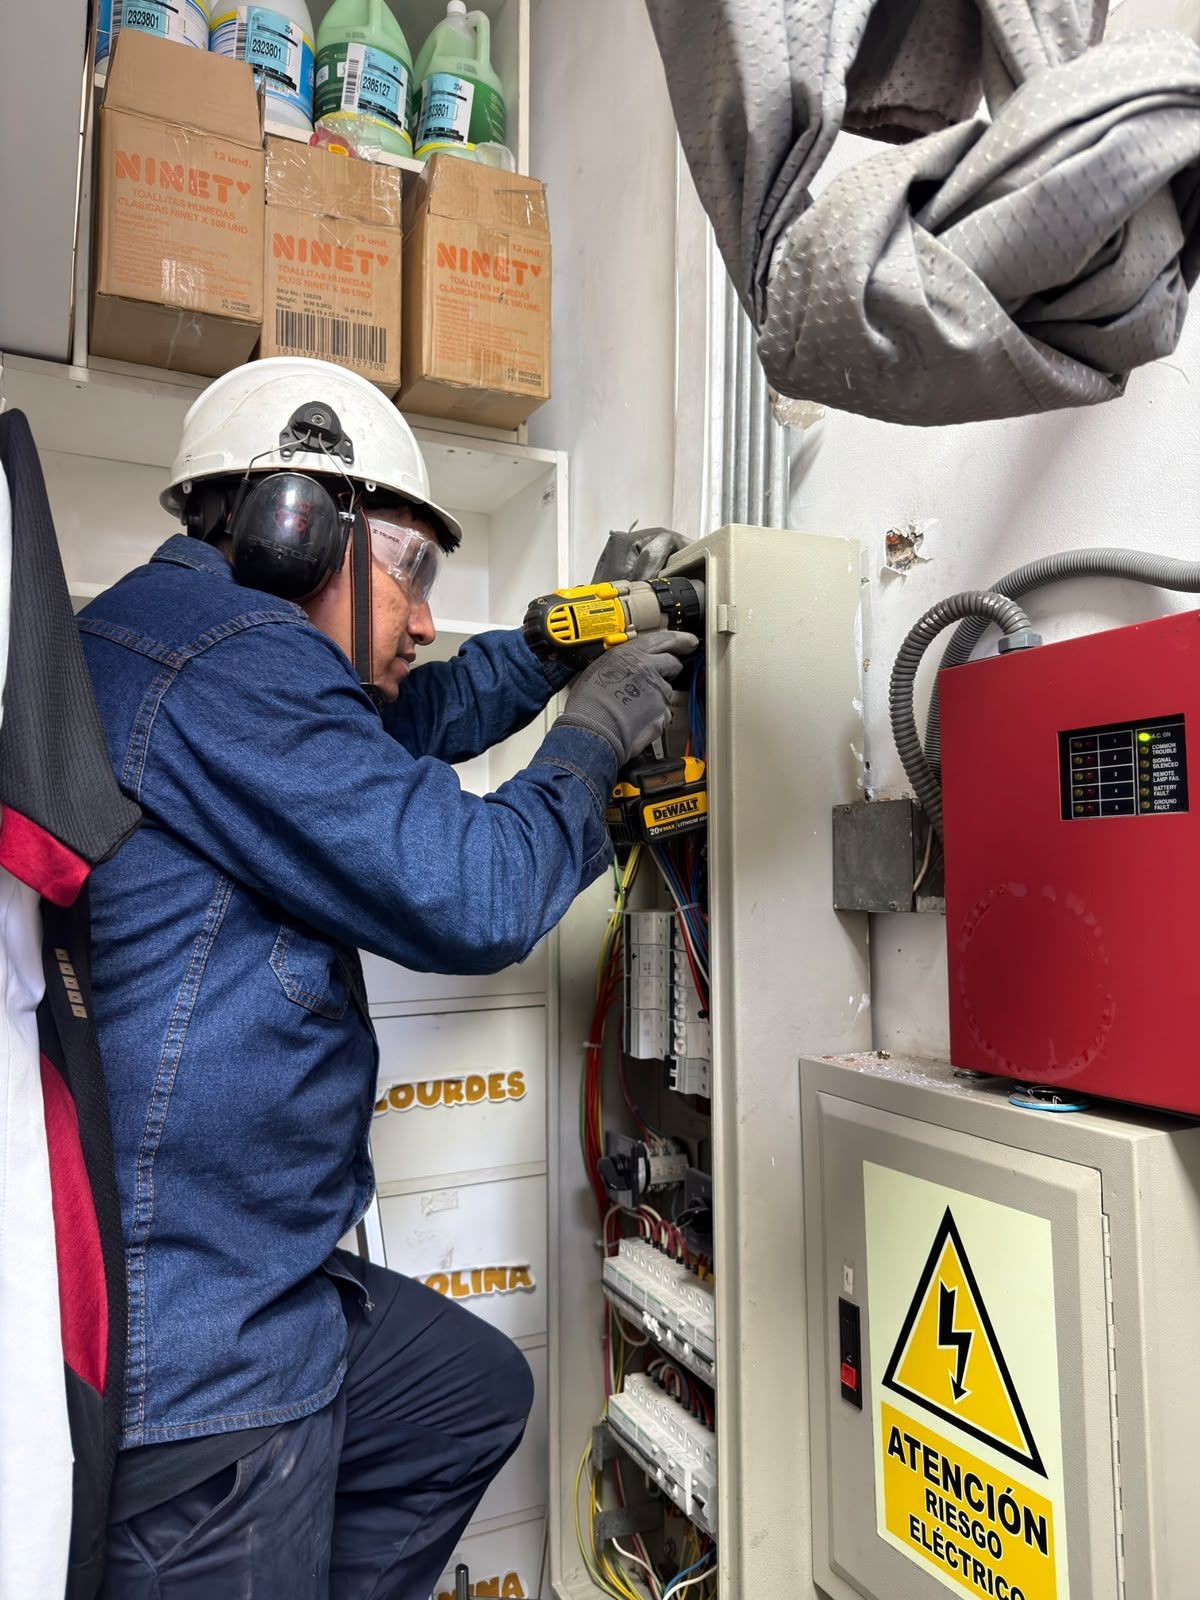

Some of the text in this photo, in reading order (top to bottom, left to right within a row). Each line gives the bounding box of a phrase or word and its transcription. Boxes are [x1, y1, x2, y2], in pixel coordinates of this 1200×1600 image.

[127, 10, 159, 29] 2323801
[252, 38, 282, 60] 2323801
[213, 151, 226, 162] 12
[115, 150, 234, 204] NINET
[133, 188, 236, 221] TOALLITAS HUMEDAS
[117, 196, 169, 216] CLASICAS
[169, 209, 198, 223] NINET
[201, 216, 209, 226] X
[227, 221, 249, 235] UND
[273, 232, 374, 276] NINET
[277, 264, 326, 280] TOALLITAS
[437, 242, 529, 286] NINET
[277, 274, 302, 287] PLUS
[303, 279, 330, 292] NINET
[439, 283, 478, 298] CLASICAS
[449, 275, 492, 292] TOALLITAS
[379, 530, 400, 544] TRUPER
[1151, 742, 1177, 750] COMMON
[1152, 761, 1179, 769] SILENCED
[663, 824, 675, 832] MAX
[417, 1266, 532, 1297] OLINA
[887, 1426, 1048, 1555] ATENCIÓN
[925, 1488, 1002, 1560] RIESGO
